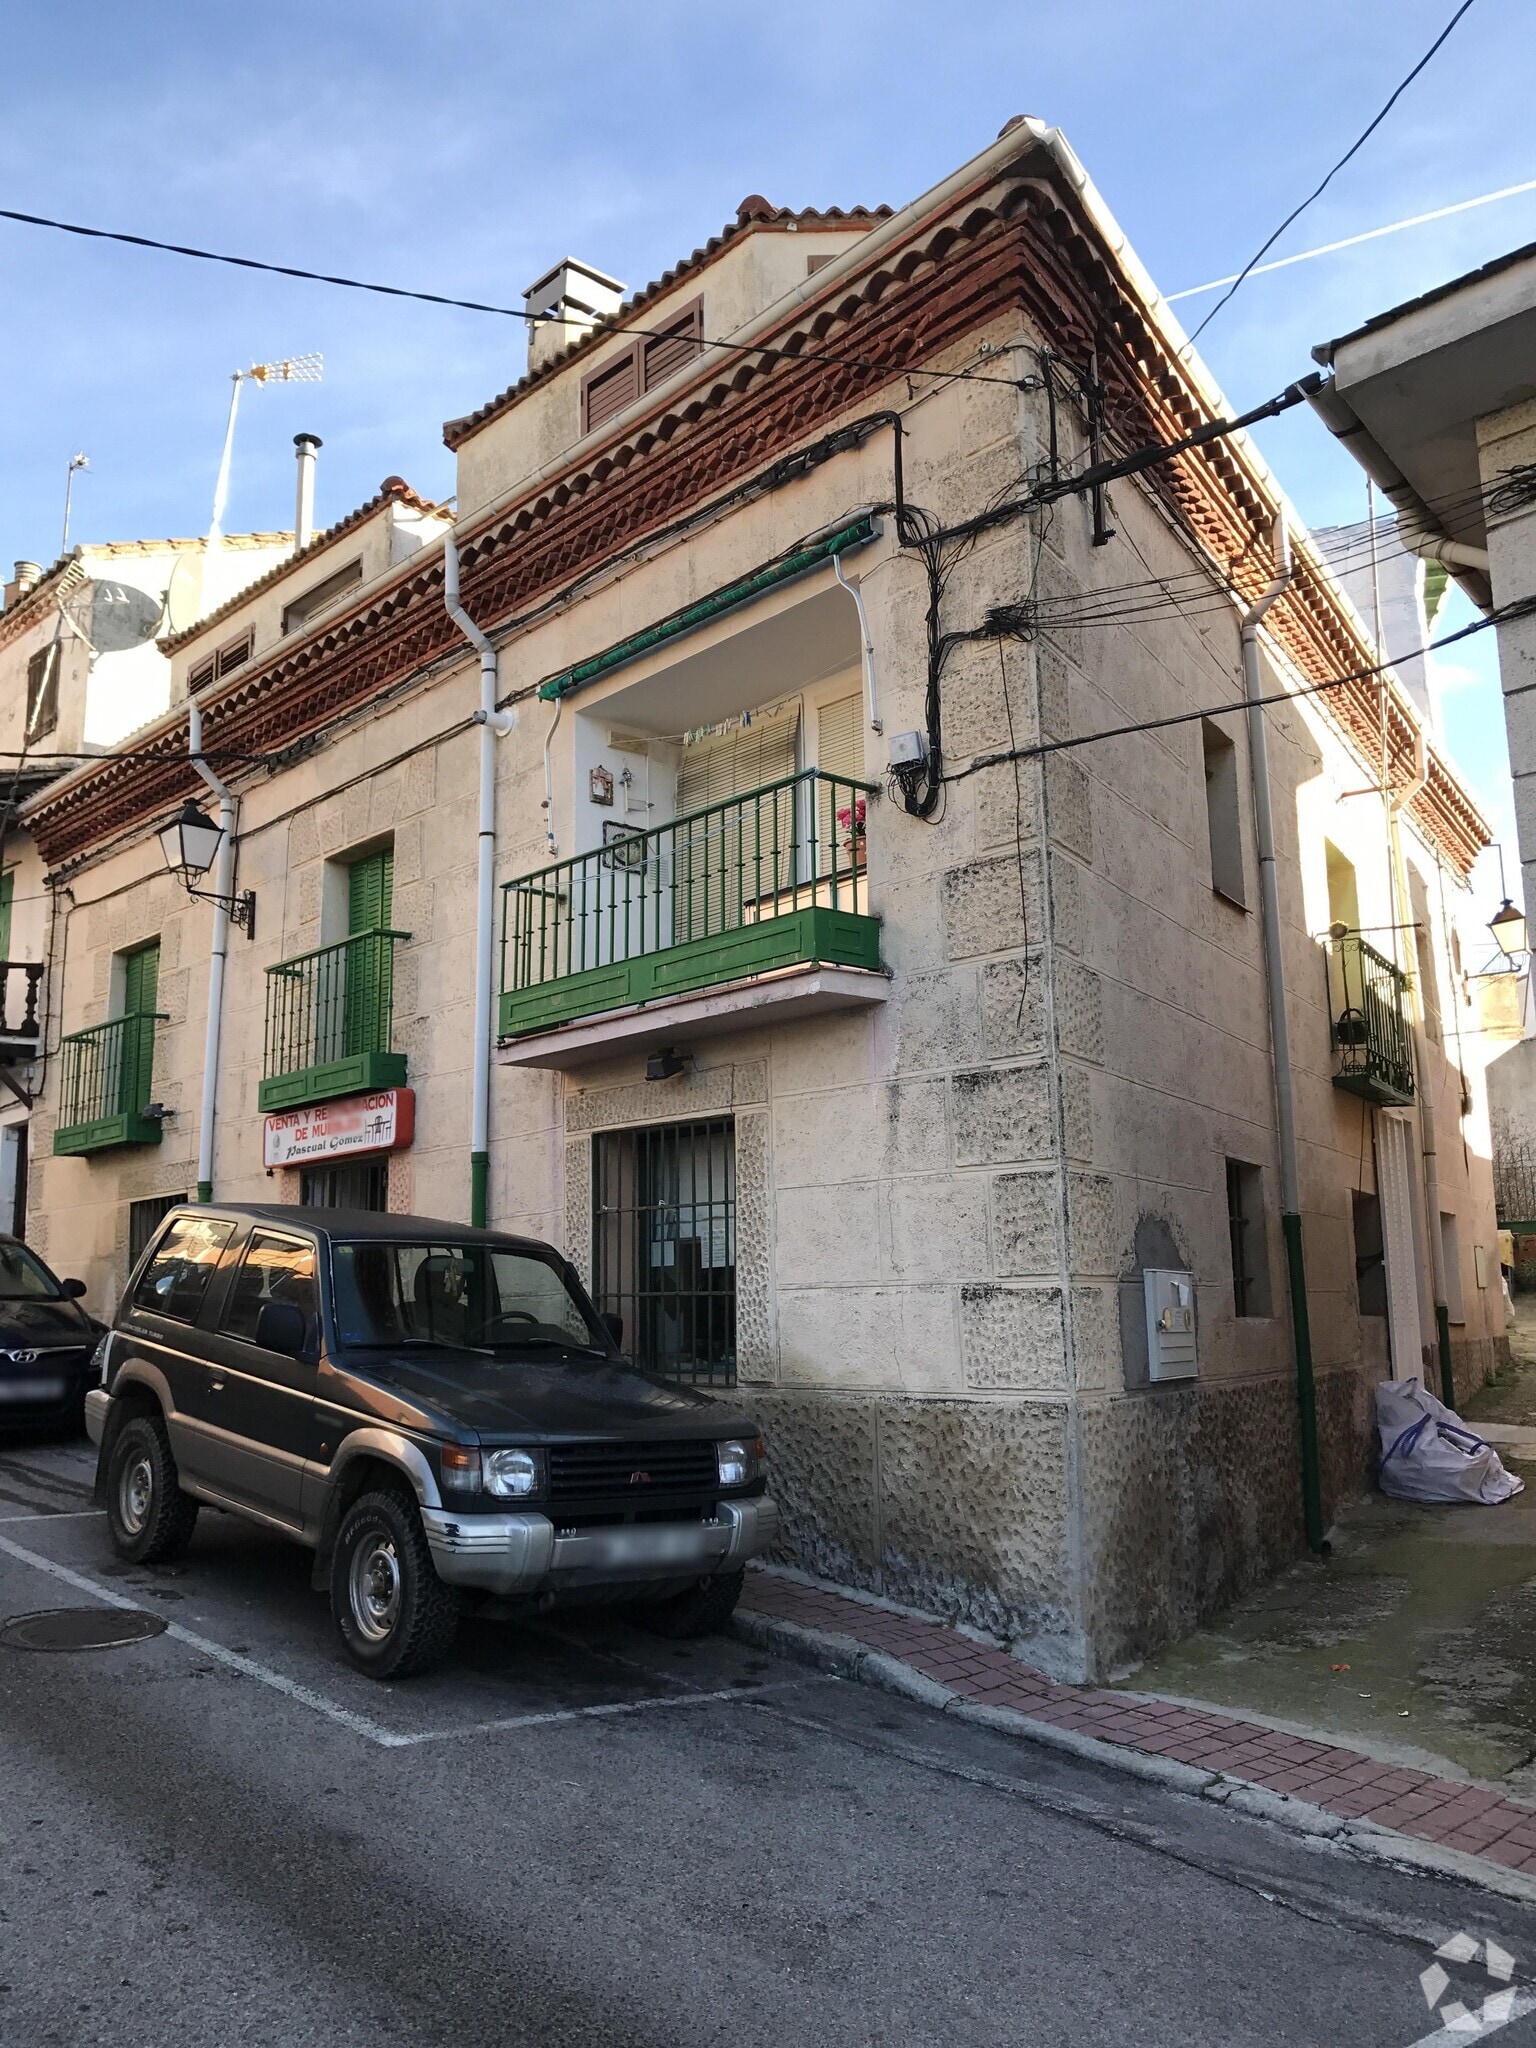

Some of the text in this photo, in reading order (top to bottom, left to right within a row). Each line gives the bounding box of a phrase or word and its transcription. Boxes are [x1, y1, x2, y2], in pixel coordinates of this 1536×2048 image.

[268, 1114, 300, 1131] VENTA
[304, 1111, 311, 1124] Y
[295, 1127, 308, 1141] DE
[286, 1139, 326, 1160] Pascual
